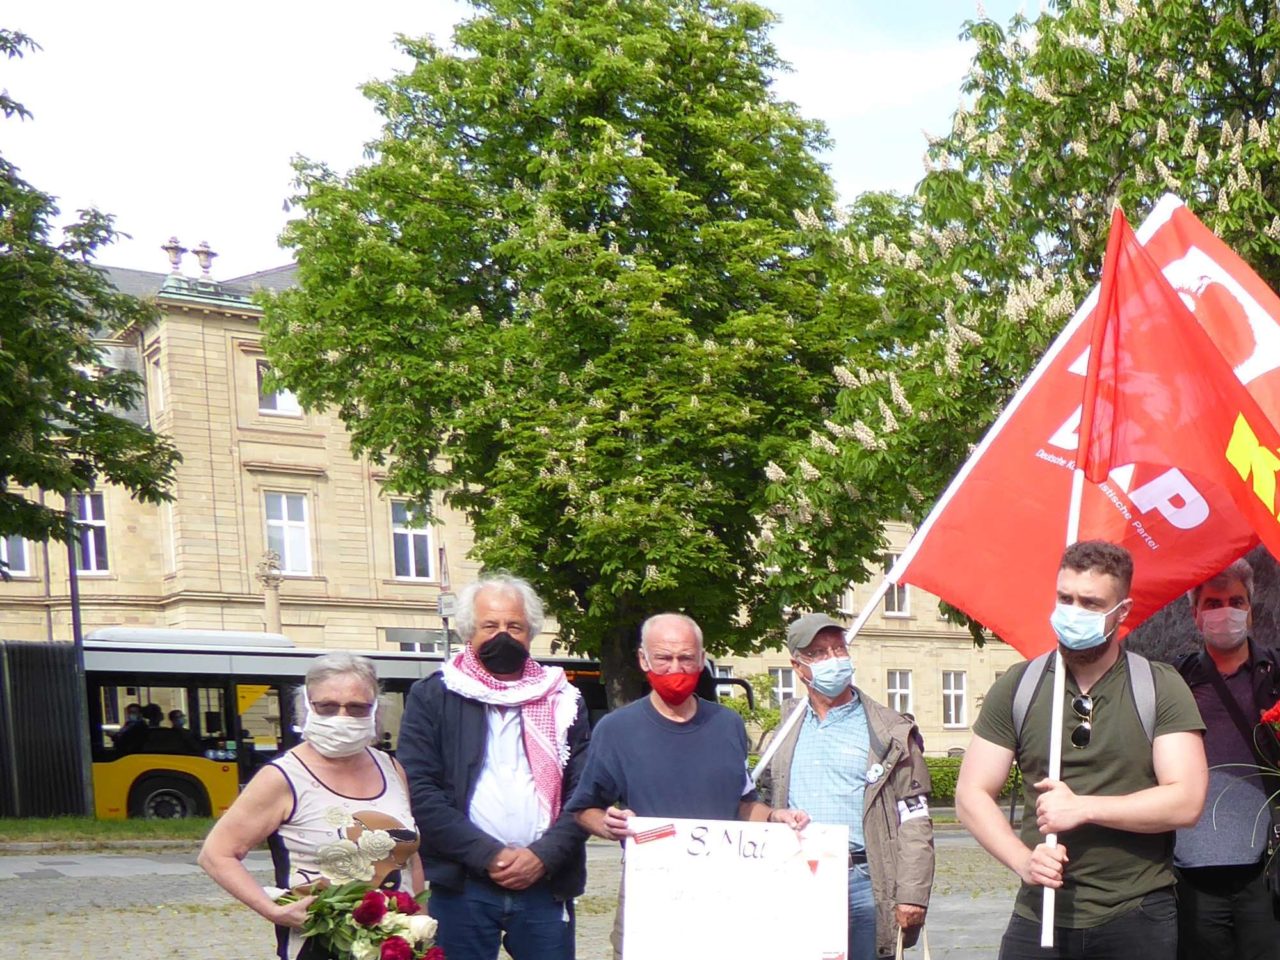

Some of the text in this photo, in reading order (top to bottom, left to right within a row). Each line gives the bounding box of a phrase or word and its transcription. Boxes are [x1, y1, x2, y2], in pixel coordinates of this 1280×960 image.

[1035, 449, 1067, 467] Deutsche
[1132, 521, 1160, 550] Partei
[721, 827, 769, 859] Mai
